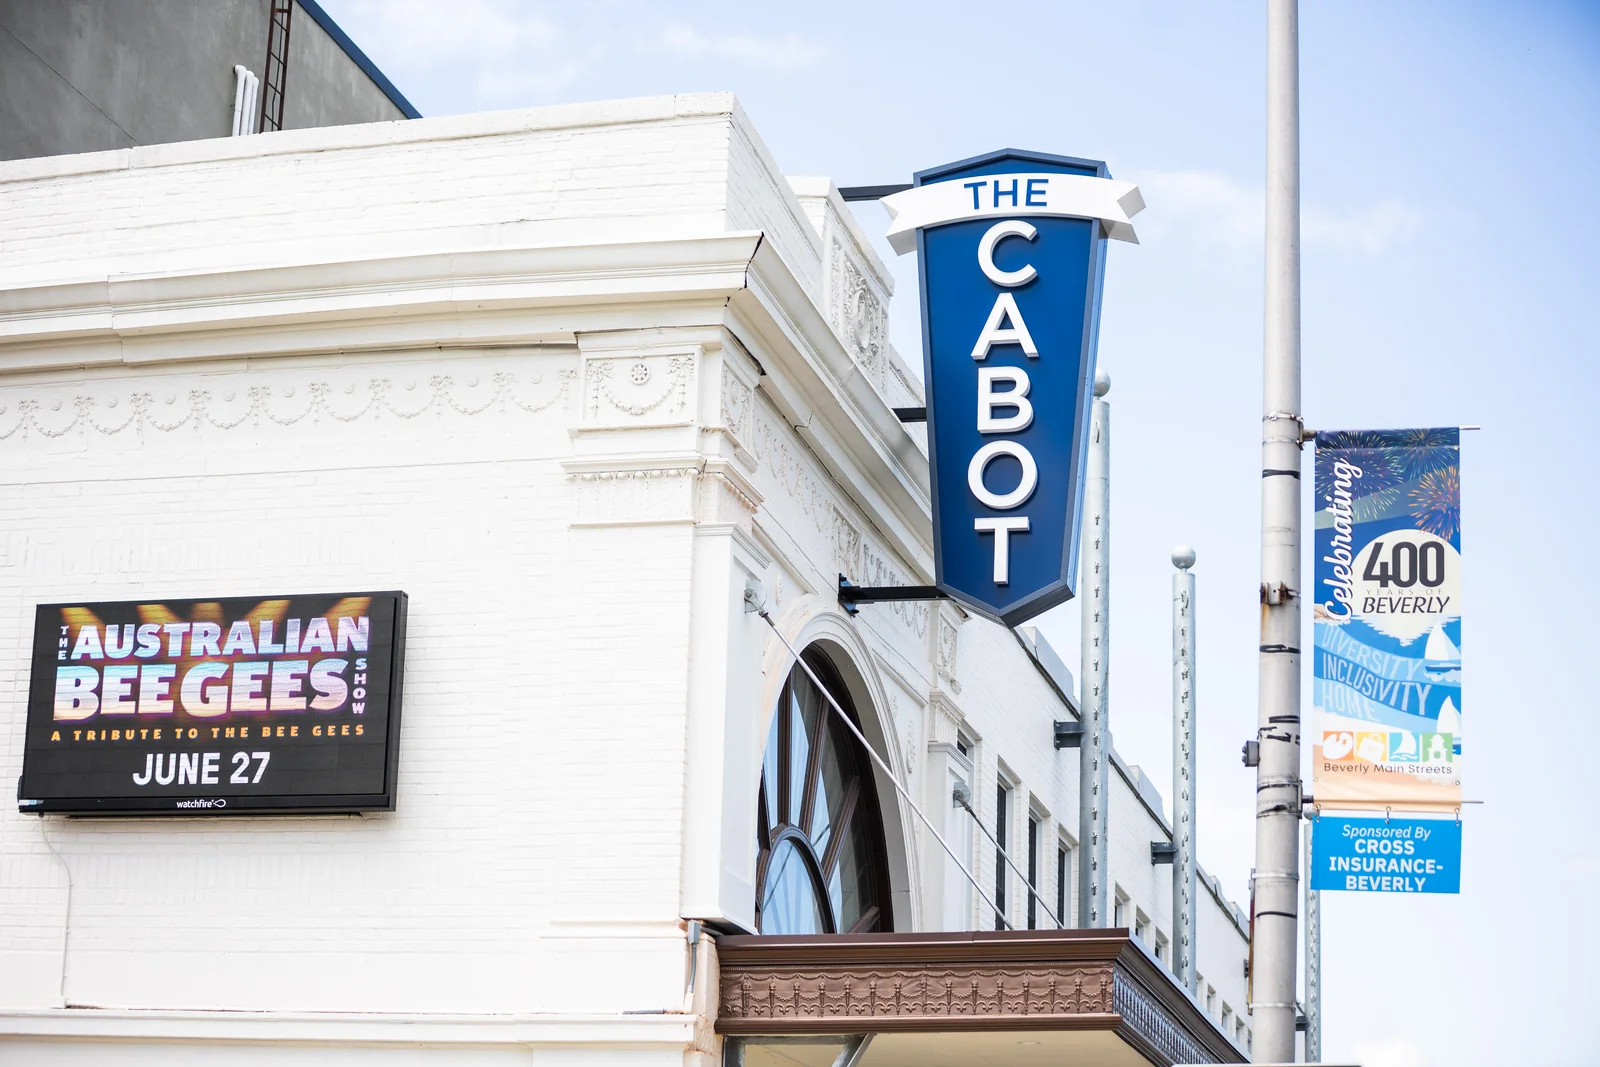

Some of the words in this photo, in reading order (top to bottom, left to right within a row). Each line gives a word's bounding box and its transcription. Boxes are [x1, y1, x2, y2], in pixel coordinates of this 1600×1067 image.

[963, 178, 1049, 210] THE
[968, 219, 1040, 585] CABOT
[1323, 457, 1363, 621] Celebrating
[1362, 540, 1445, 588] 400
[1362, 596, 1450, 614] BEVERLY
[1366, 588, 1414, 596] YEARS
[1426, 588, 1443, 596] OF
[57, 625, 67, 660] THE
[70, 615, 370, 660] AUSTRALIAN
[1322, 624, 1424, 680] DIVERSITY
[352, 657, 367, 714] SHOW
[1323, 652, 1432, 716] INCLUSIVITY
[1321, 680, 1380, 722] HOME
[51, 730, 61, 741] A
[74, 728, 162, 741] TRIBUTE
[175, 727, 199, 740] TO
[212, 726, 249, 739] THE
[262, 725, 300, 737] BEE
[312, 724, 365, 736] GEES
[133, 752, 220, 786] JUNE
[230, 751, 271, 785] 27
[1324, 762, 1370, 775] Beverly
[1373, 763, 1404, 774] Main
[1408, 764, 1452, 774] Streets
[176, 799, 212, 808] watchfire
[1342, 824, 1411, 840] Sponsored
[1415, 827, 1431, 841] By
[1354, 839, 1415, 855] CROSS
[1329, 856, 1444, 874] INSURANCE-
[1345, 875, 1426, 892] BEVERLY
